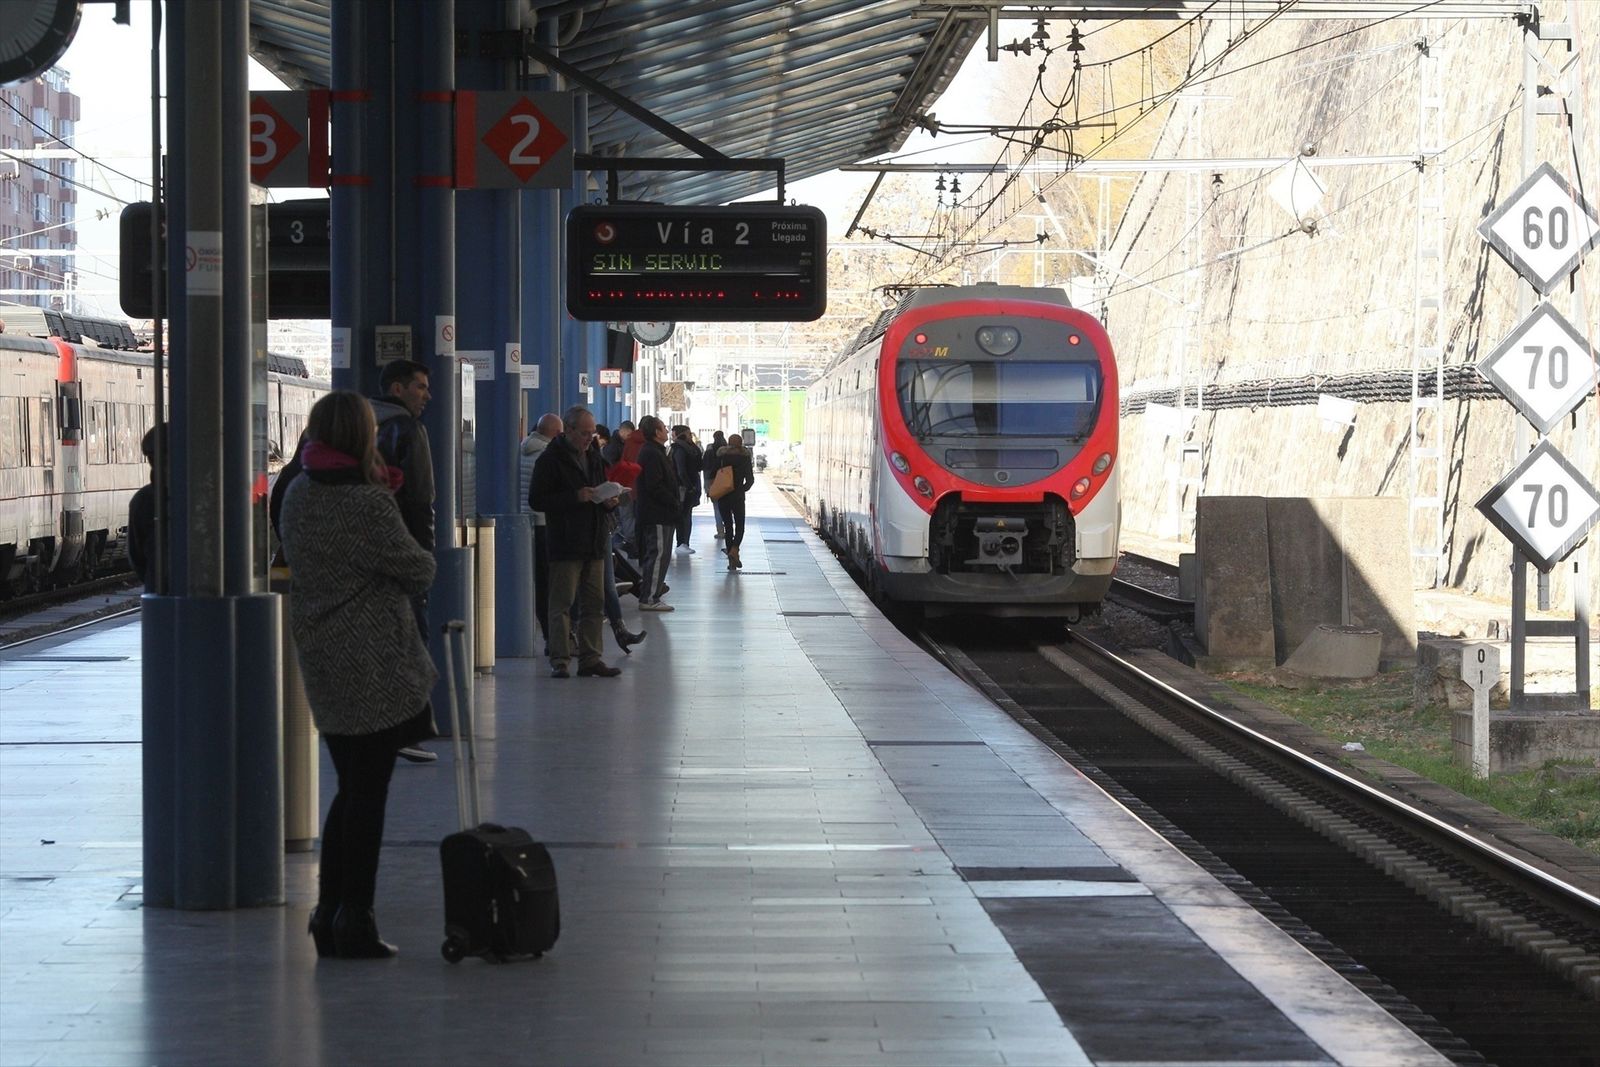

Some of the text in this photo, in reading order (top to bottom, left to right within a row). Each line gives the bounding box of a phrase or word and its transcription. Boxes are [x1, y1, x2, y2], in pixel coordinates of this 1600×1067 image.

[249, 113, 277, 165] 3
[509, 113, 541, 165] 2
[290, 220, 304, 244] 3
[657, 221, 750, 245] Vía 2
[771, 220, 808, 231] Próxima
[1523, 206, 1569, 250] 60
[772, 232, 807, 244] Llegada
[593, 254, 723, 270] SIN SERVIC
[1523, 345, 1569, 390] 70
[1523, 484, 1569, 528] 70
[1477, 648, 1486, 664] 0
[1479, 669, 1484, 685] 1
